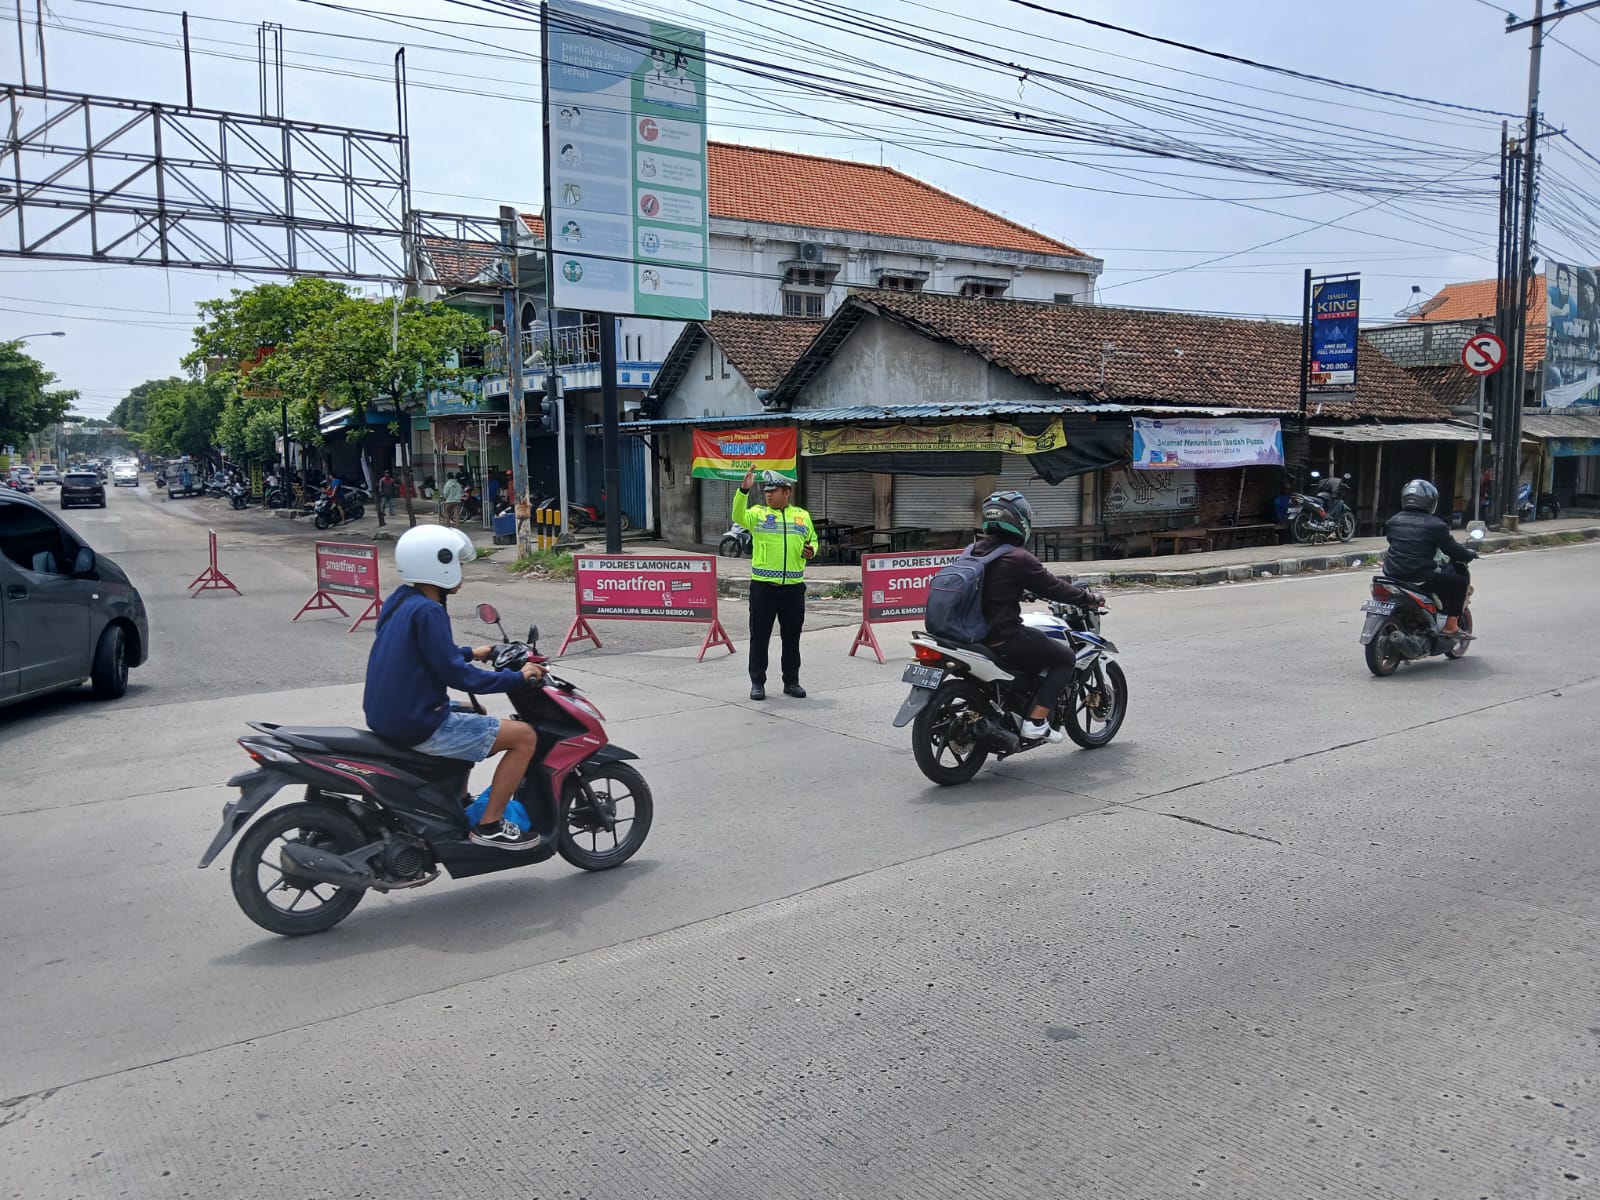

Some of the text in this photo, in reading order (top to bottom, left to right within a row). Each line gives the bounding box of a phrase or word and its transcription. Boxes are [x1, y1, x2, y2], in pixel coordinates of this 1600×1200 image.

[562, 43, 632, 65] perilaku hidup
[562, 54, 614, 71] bersih dan
[561, 66, 590, 79] sehat
[1317, 299, 1357, 313] KING
[720, 440, 766, 456] WARMINDO
[1157, 438, 1265, 447] Selamat Menunaikan Ibadah Puasa
[326, 560, 356, 573] smartfren
[599, 561, 690, 570] POLRES LAMONGAN
[892, 558, 931, 568] POLRES
[596, 576, 666, 591] smartfren
[640, 608, 665, 616] SELALU
[881, 608, 900, 616] JAGA
[901, 607, 924, 615] EMOSI
